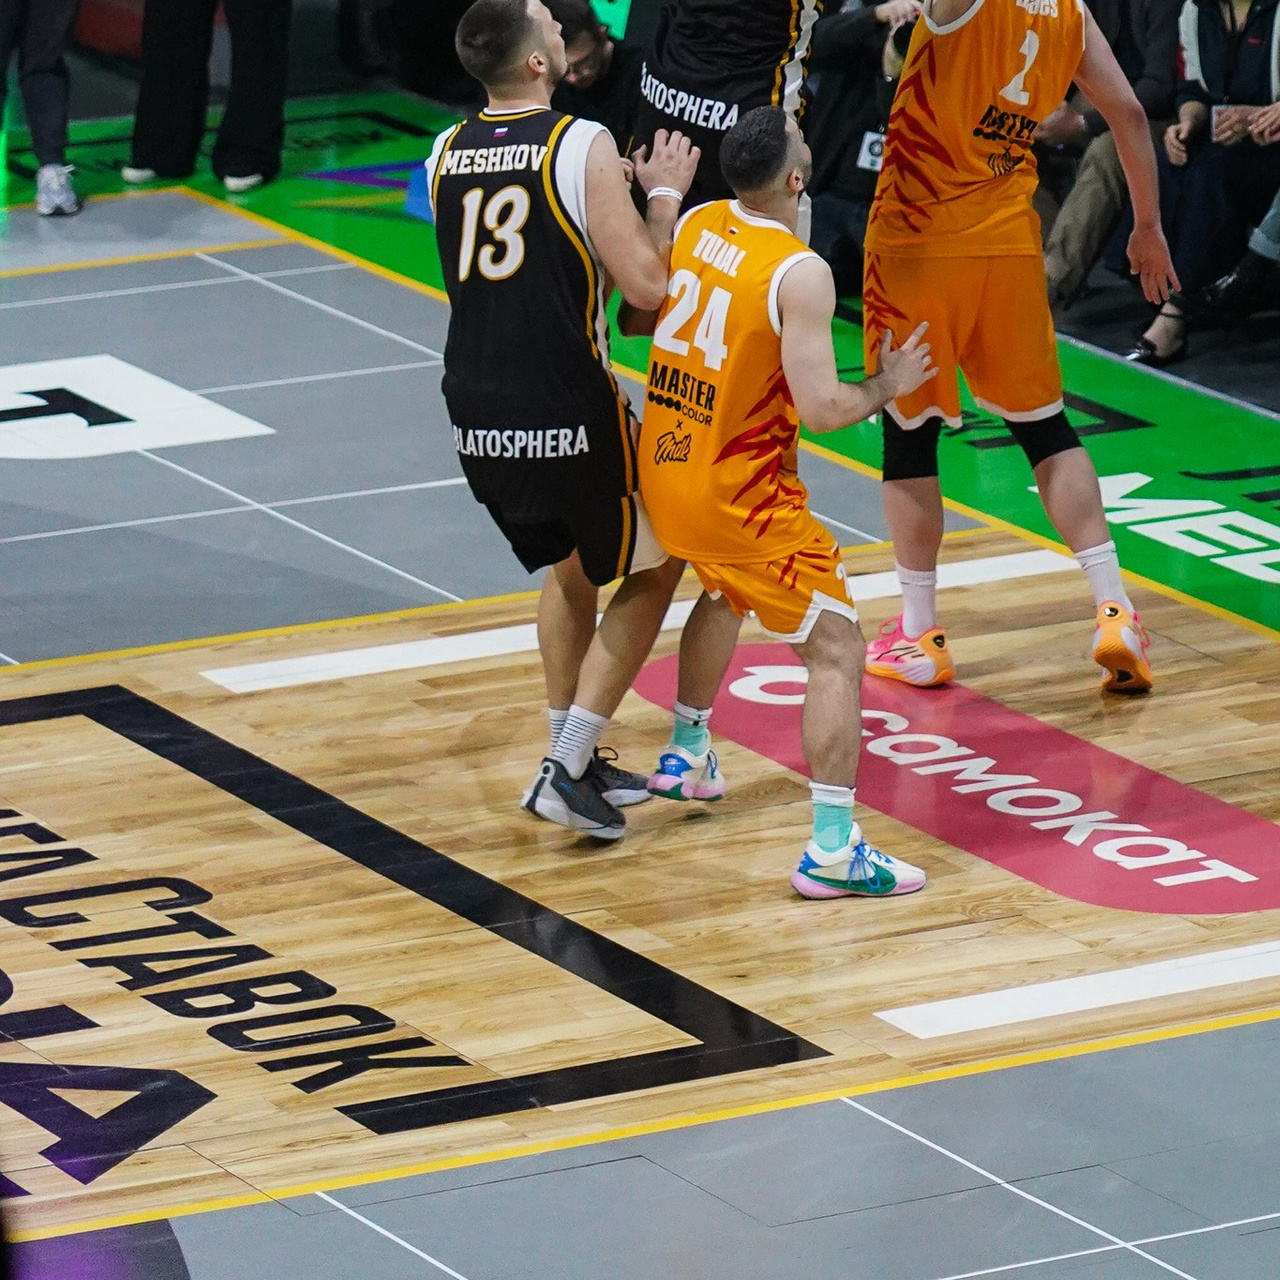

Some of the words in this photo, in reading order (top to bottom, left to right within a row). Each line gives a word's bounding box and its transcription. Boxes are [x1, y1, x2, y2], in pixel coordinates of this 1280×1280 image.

[998, 29, 1040, 106] 2
[439, 143, 549, 176] MESHKOV
[458, 184, 531, 282] 13
[653, 268, 733, 372] 24
[649, 360, 716, 412] MASTER
[681, 404, 713, 427] COLOR
[0, 876, 473, 1094] СТАВОК
